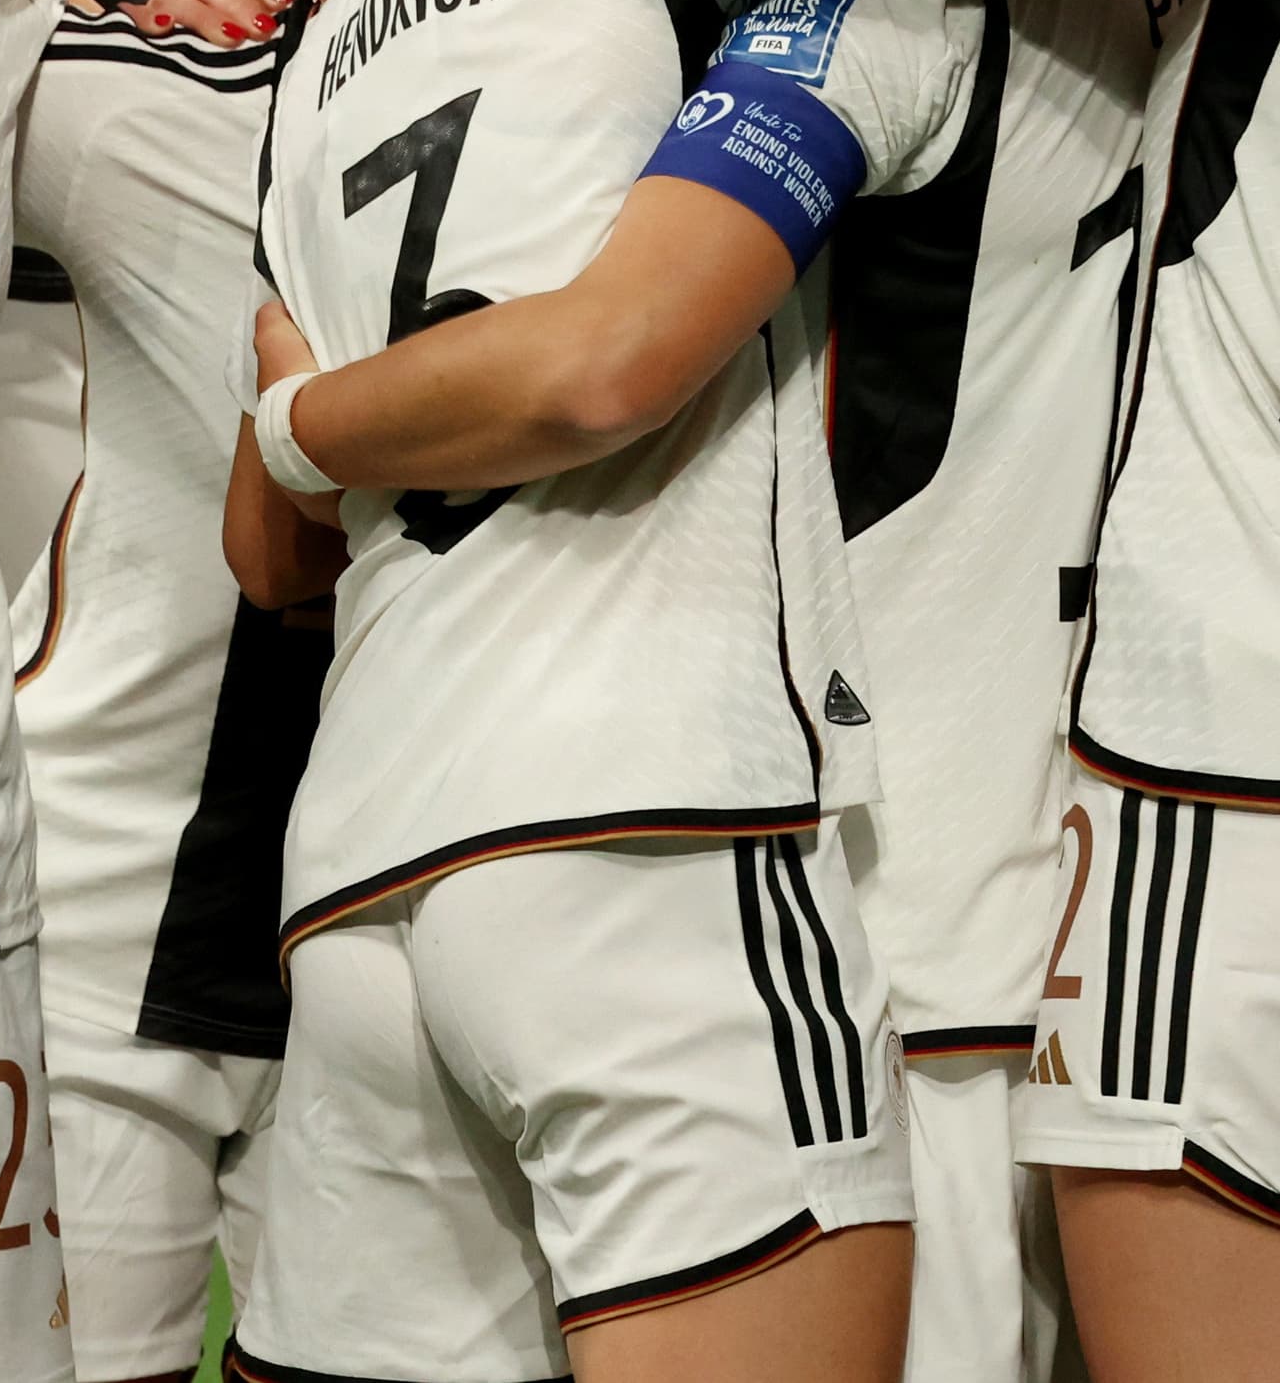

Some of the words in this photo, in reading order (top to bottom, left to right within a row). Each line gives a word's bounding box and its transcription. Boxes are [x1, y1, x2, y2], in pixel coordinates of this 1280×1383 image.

[743, 16, 765, 35] the
[765, 15, 818, 38] World
[755, 39, 783, 50] FIFA
[744, 101, 781, 129] Unite
[781, 122, 802, 142] For
[721, 136, 786, 180] AGAINST
[783, 173, 824, 228] WOMEN
[732, 119, 788, 160] ENDING
[786, 151, 835, 217] VIOLENCE
